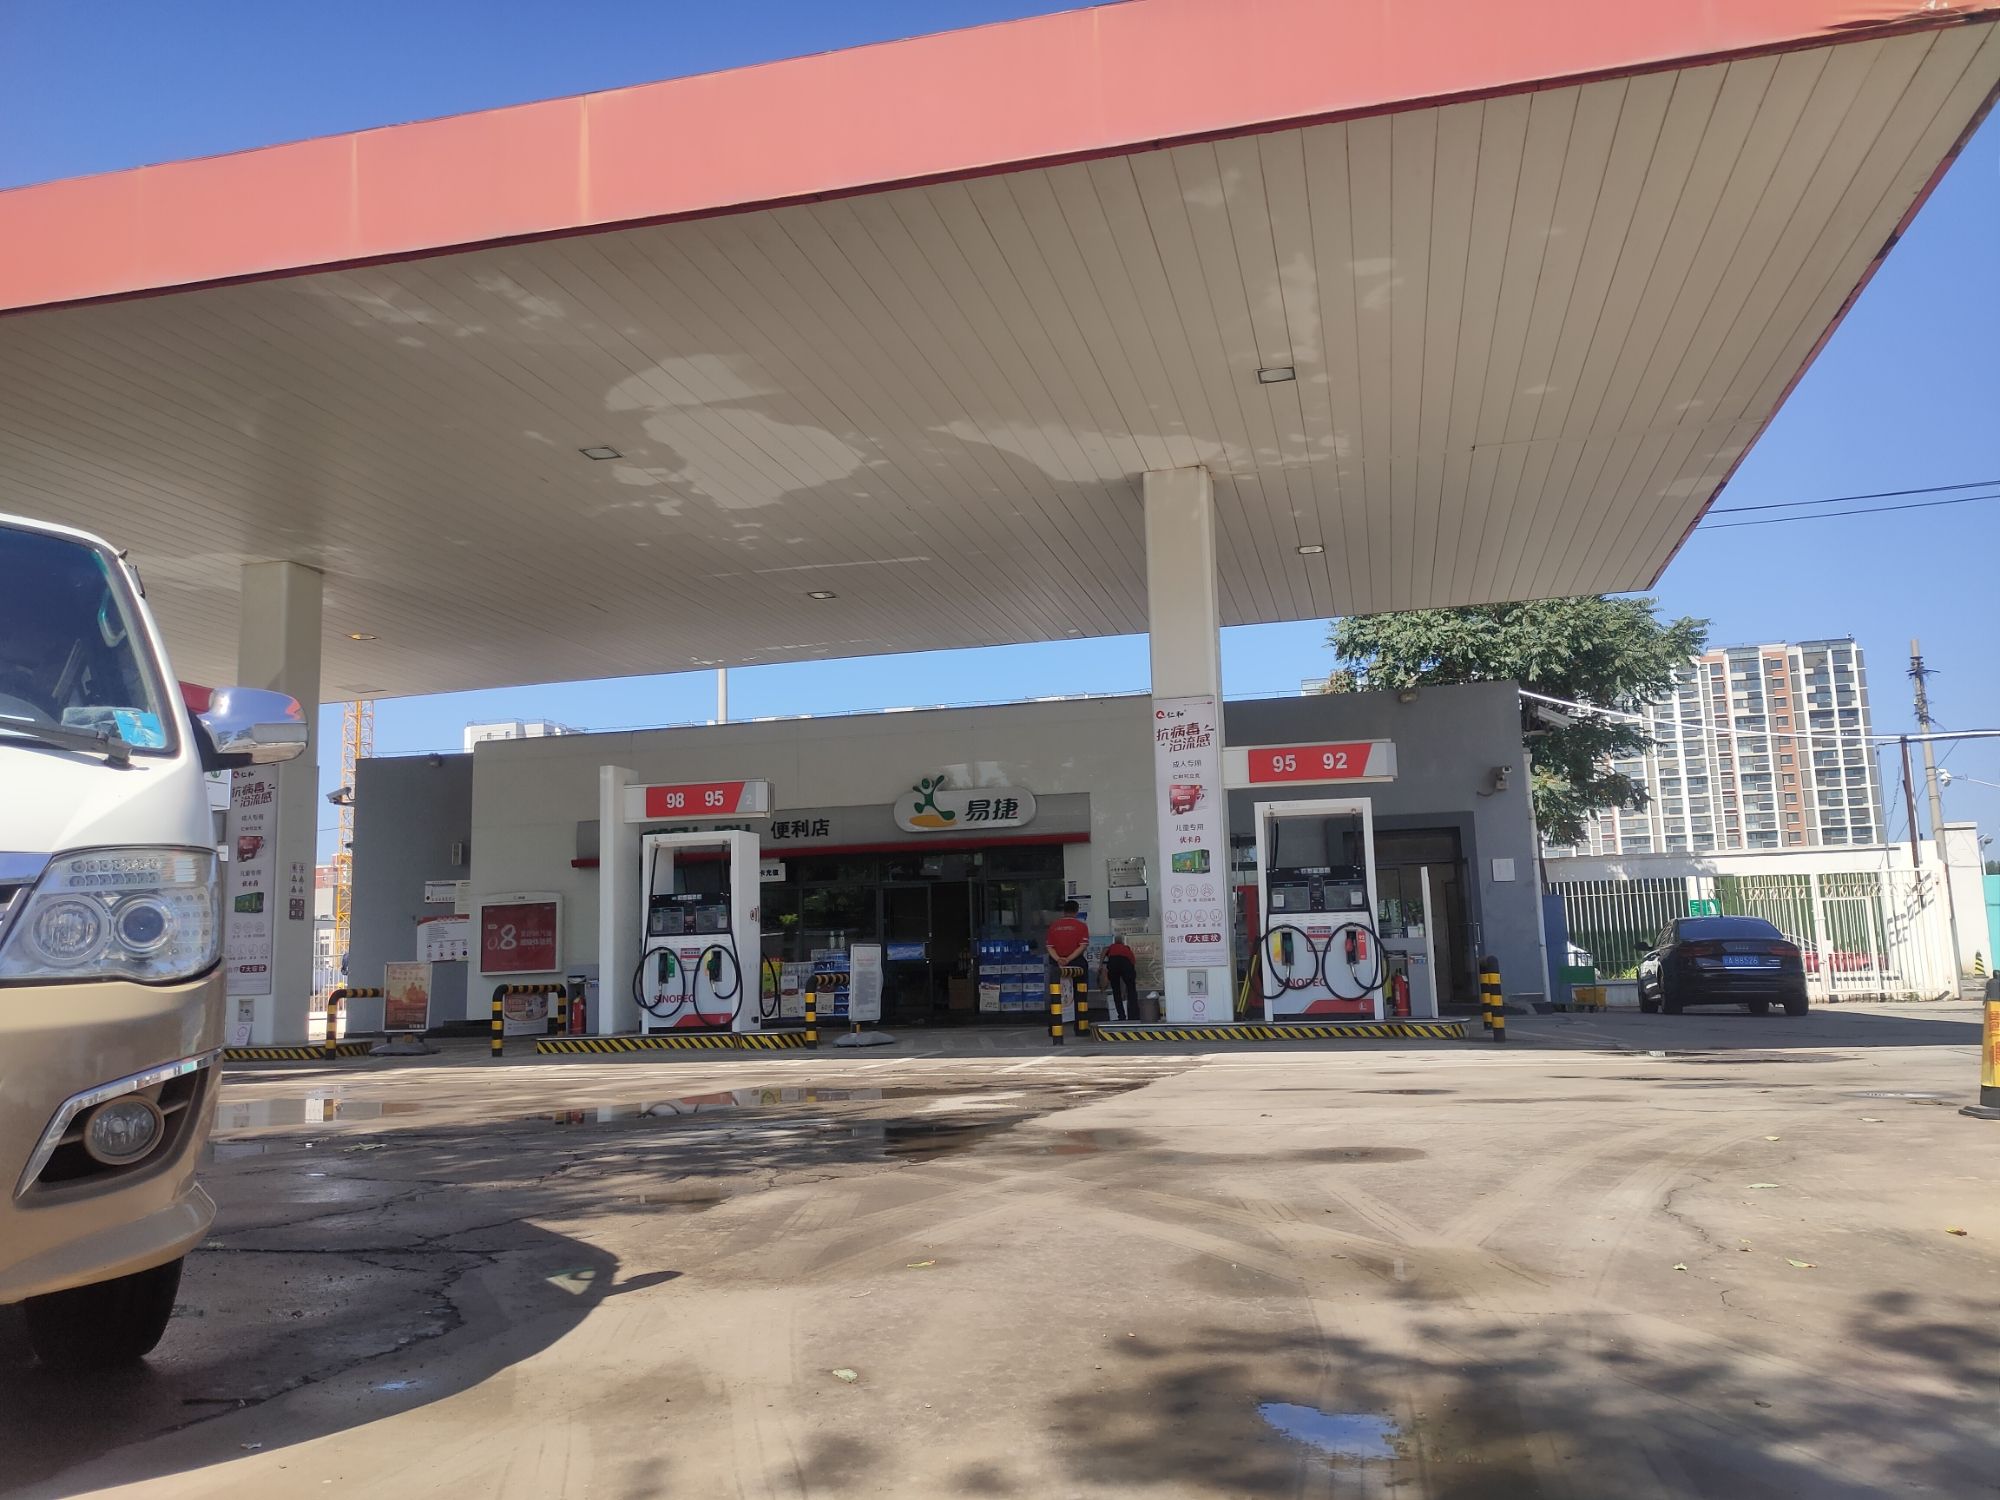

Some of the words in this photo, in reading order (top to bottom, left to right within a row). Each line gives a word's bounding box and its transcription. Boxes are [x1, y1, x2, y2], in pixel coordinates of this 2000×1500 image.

[1167, 710, 1184, 718] 仁和
[1156, 722, 1200, 741] 抗病毒
[1169, 733, 1211, 752] 治流感
[1272, 754, 1297, 773] 95
[1322, 752, 1348, 770] 92
[232, 782, 265, 798] 抗病毒
[240, 791, 272, 808] 治流感
[666, 792, 685, 809] 98
[704, 790, 724, 807] 95
[965, 798, 1019, 821] 易捷
[770, 818, 830, 840] 便利店
